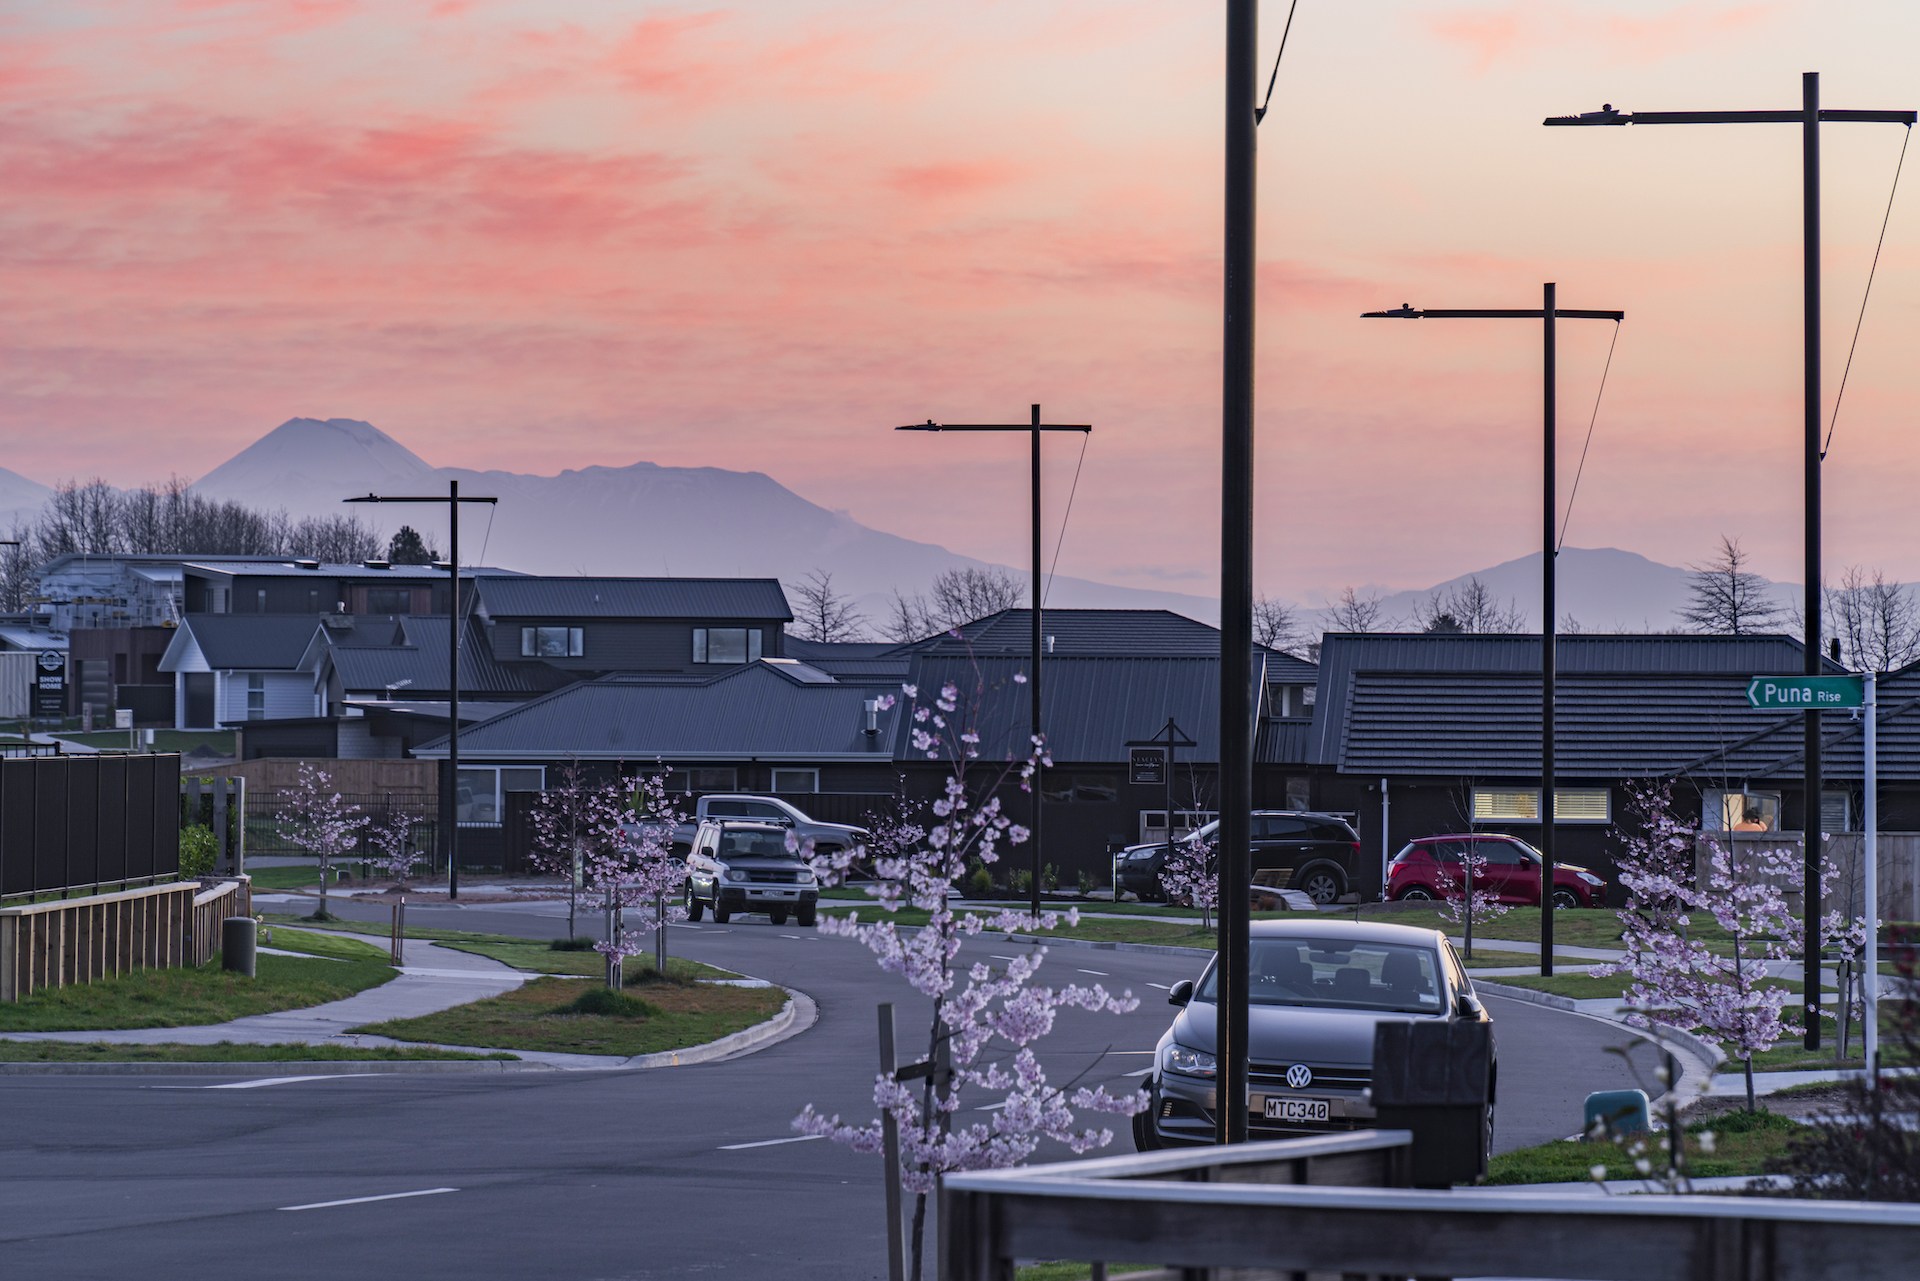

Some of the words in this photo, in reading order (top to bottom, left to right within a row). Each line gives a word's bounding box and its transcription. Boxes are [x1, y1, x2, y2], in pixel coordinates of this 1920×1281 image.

[1765, 684, 1812, 703] Puna
[1817, 691, 1842, 703] Rise
[1286, 1063, 1313, 1089] VW
[1267, 1101, 1326, 1119] MTC340
